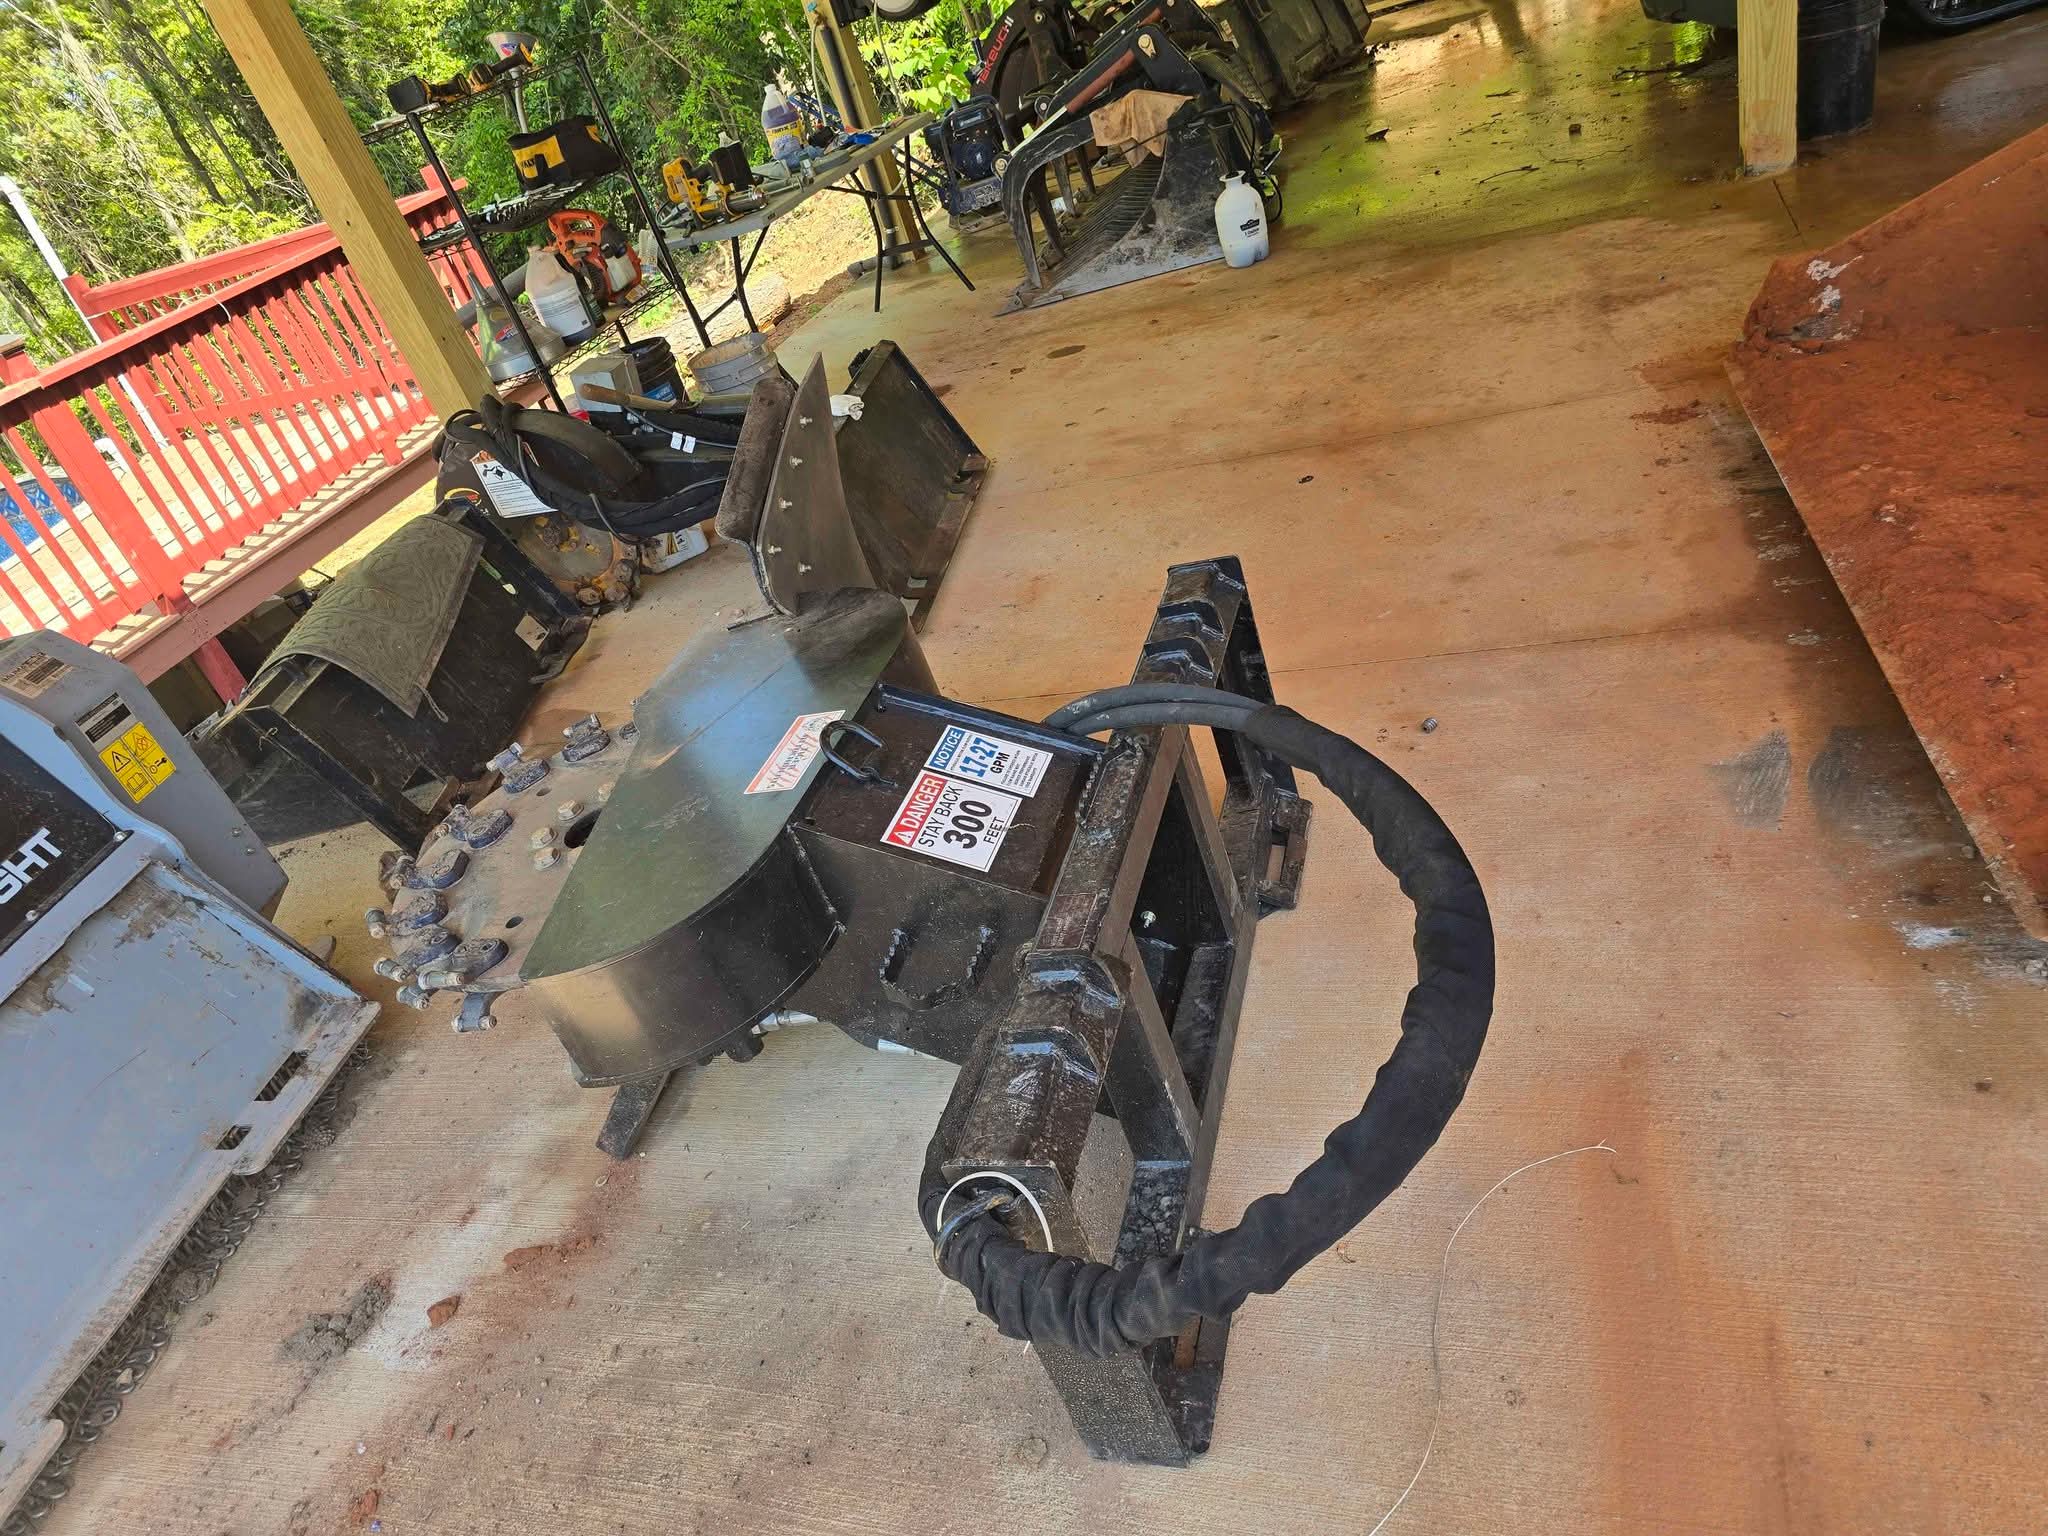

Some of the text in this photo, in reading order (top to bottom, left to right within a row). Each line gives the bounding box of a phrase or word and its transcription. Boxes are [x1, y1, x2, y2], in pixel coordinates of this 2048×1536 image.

[933, 730, 962, 767] NOTICE
[959, 737, 999, 777] 17-27
[990, 752, 1010, 774] GPM
[900, 777, 944, 829] DANGER
[918, 817, 945, 847] STAY
[934, 785, 963, 817] BACK
[943, 800, 992, 849] 300
[983, 816, 1005, 844] FEET
